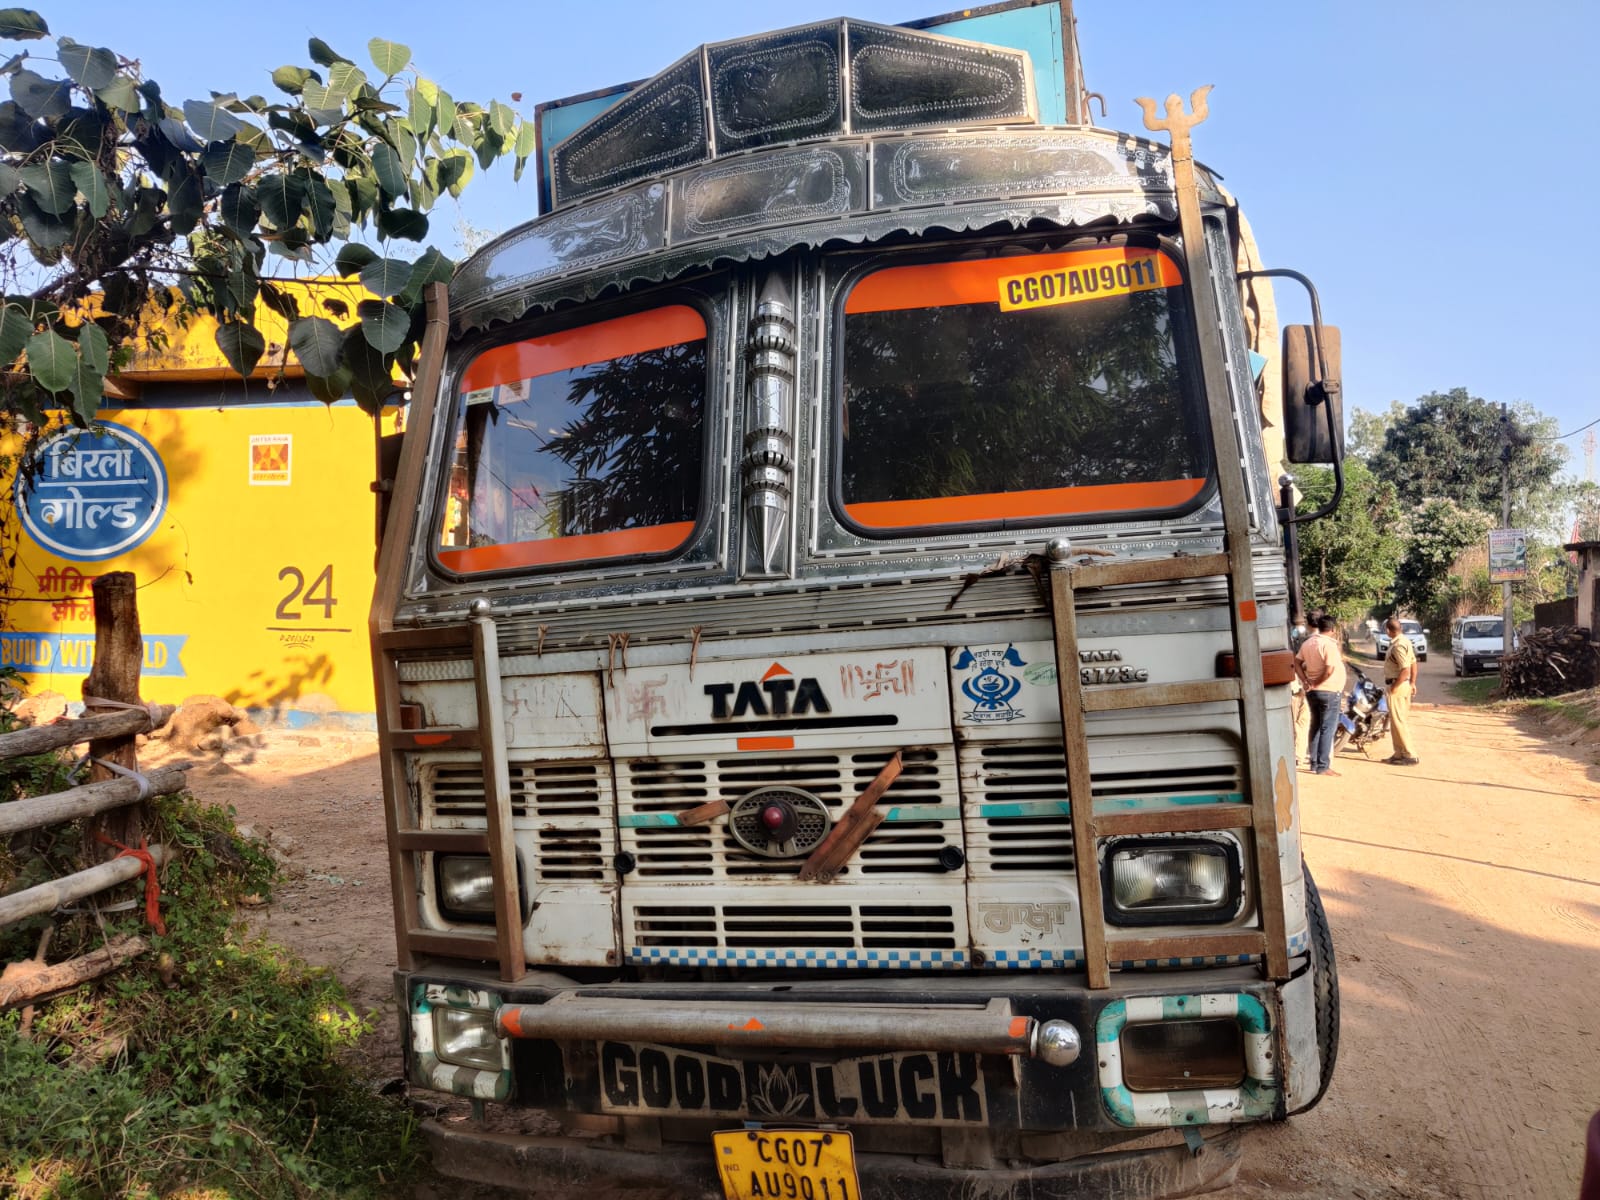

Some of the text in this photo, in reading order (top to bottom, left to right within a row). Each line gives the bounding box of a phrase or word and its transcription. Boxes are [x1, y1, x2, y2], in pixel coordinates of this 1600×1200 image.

[1006, 258, 1156, 305] CG07AU9011
[49, 441, 133, 479] बिरला
[40, 486, 142, 529] गोल्ड
[276, 564, 338, 620] 24
[1, 638, 52, 666] BUILD
[60, 639, 95, 667] WIT
[1079, 649, 1122, 663] TATA
[703, 678, 832, 718] TATA
[602, 1041, 984, 1121] GOOD LUCK
[757, 1138, 823, 1167] CG07
[751, 1170, 849, 1200] AU9011
